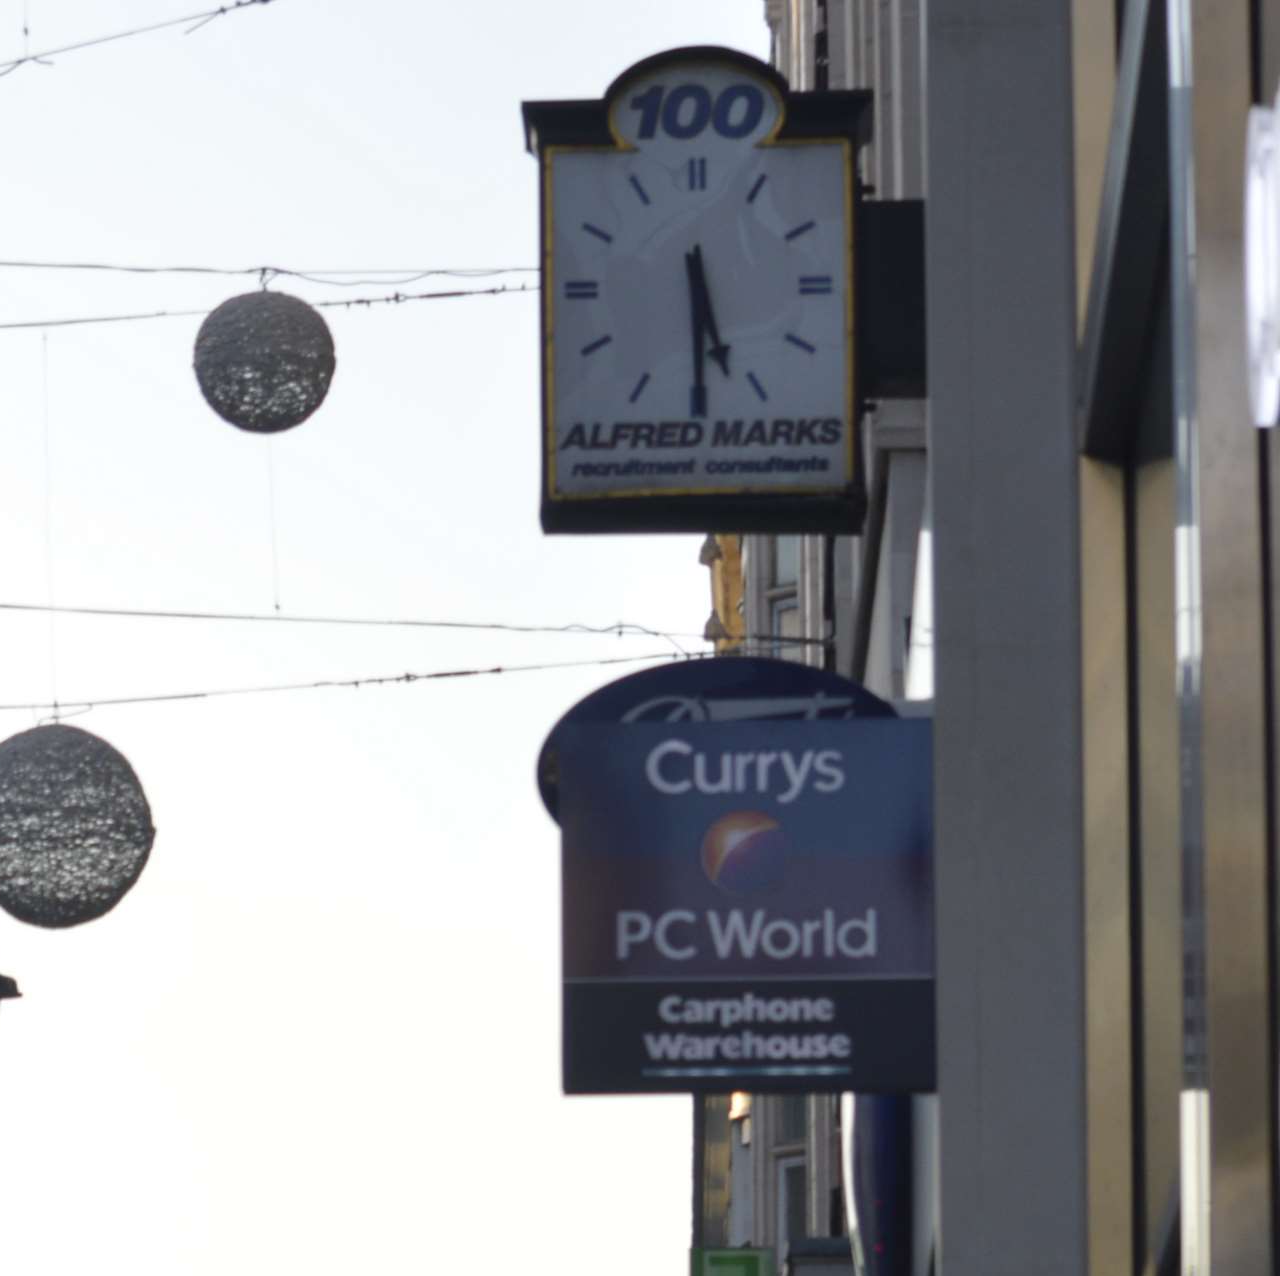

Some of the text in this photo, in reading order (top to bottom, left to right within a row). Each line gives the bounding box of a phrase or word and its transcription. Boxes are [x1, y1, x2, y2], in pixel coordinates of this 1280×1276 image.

[630, 84, 765, 139] 100
[560, 418, 842, 450] ALFRED MARKS
[571, 455, 829, 477] recruitment consultants
[646, 738, 845, 803] Currys
[616, 908, 877, 960] PC World
[659, 993, 834, 1027] Carphone
[643, 1030, 850, 1060] Warehouse
